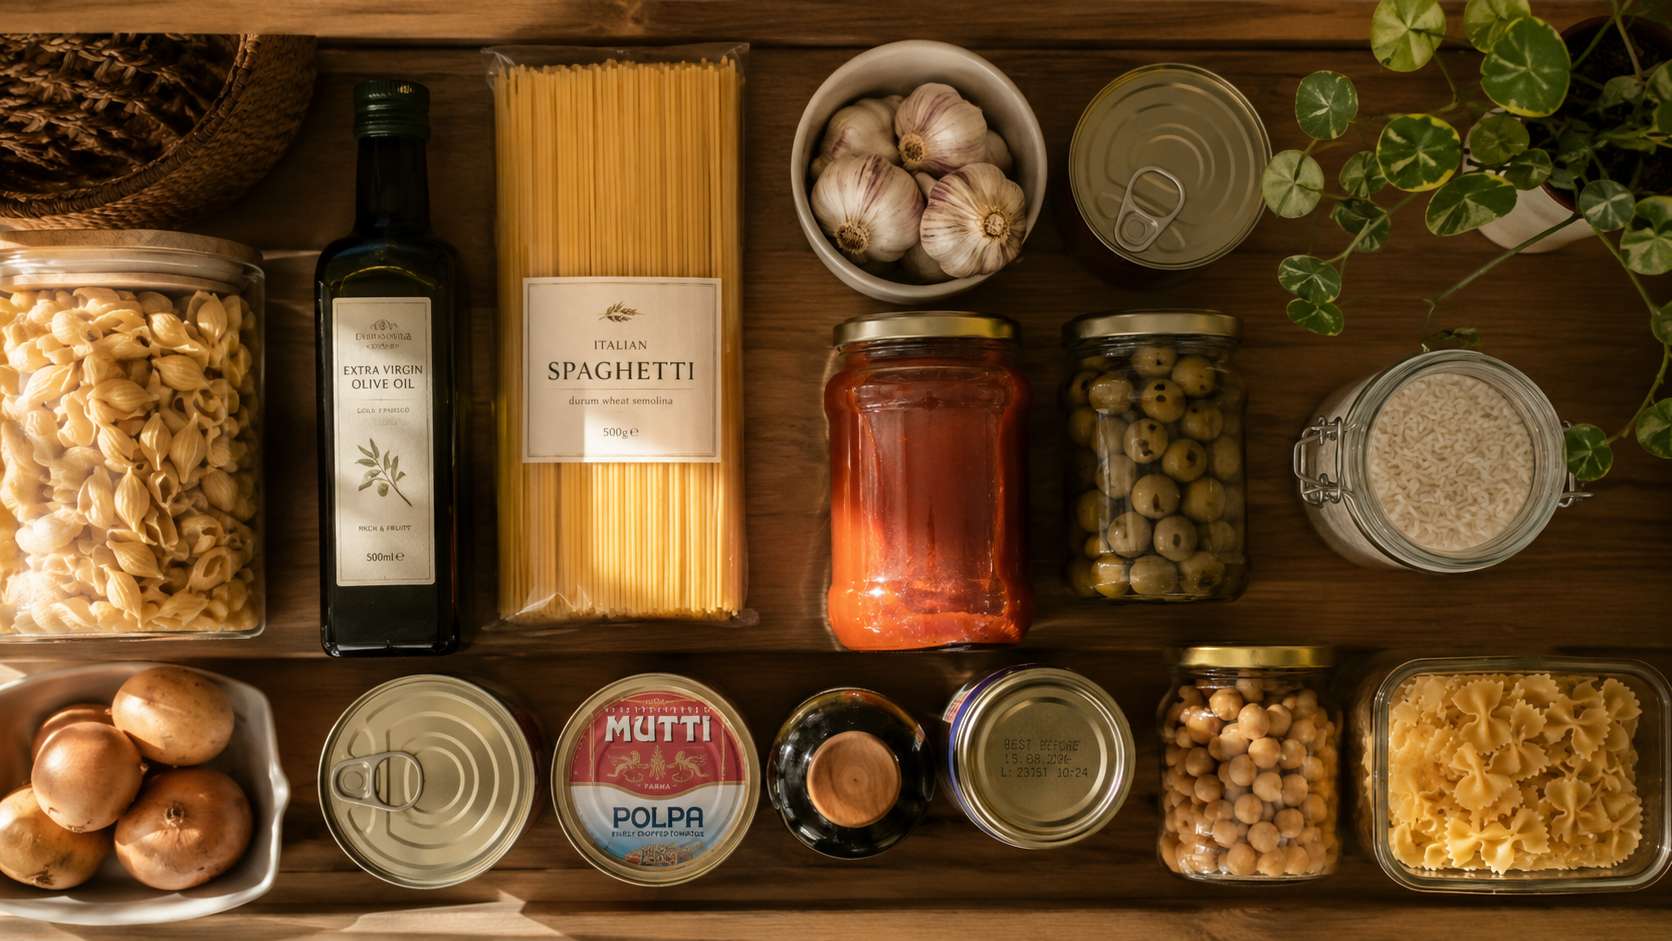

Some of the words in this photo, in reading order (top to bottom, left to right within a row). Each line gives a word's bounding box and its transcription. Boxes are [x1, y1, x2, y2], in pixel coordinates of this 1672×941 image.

[594, 340, 647, 350] ITALIAN
[343, 366, 379, 375] EXTRA
[383, 365, 423, 375] VIRGIN
[548, 361, 694, 381] SPAGHETTI
[351, 379, 389, 389] OLIVE
[393, 379, 415, 389] OIL
[569, 396, 599, 405] durum
[602, 396, 629, 405] wheat
[633, 396, 673, 405] semolina
[604, 715, 712, 742] MUTTI
[1003, 738, 1032, 750] BEST
[613, 806, 704, 829] POLPA
